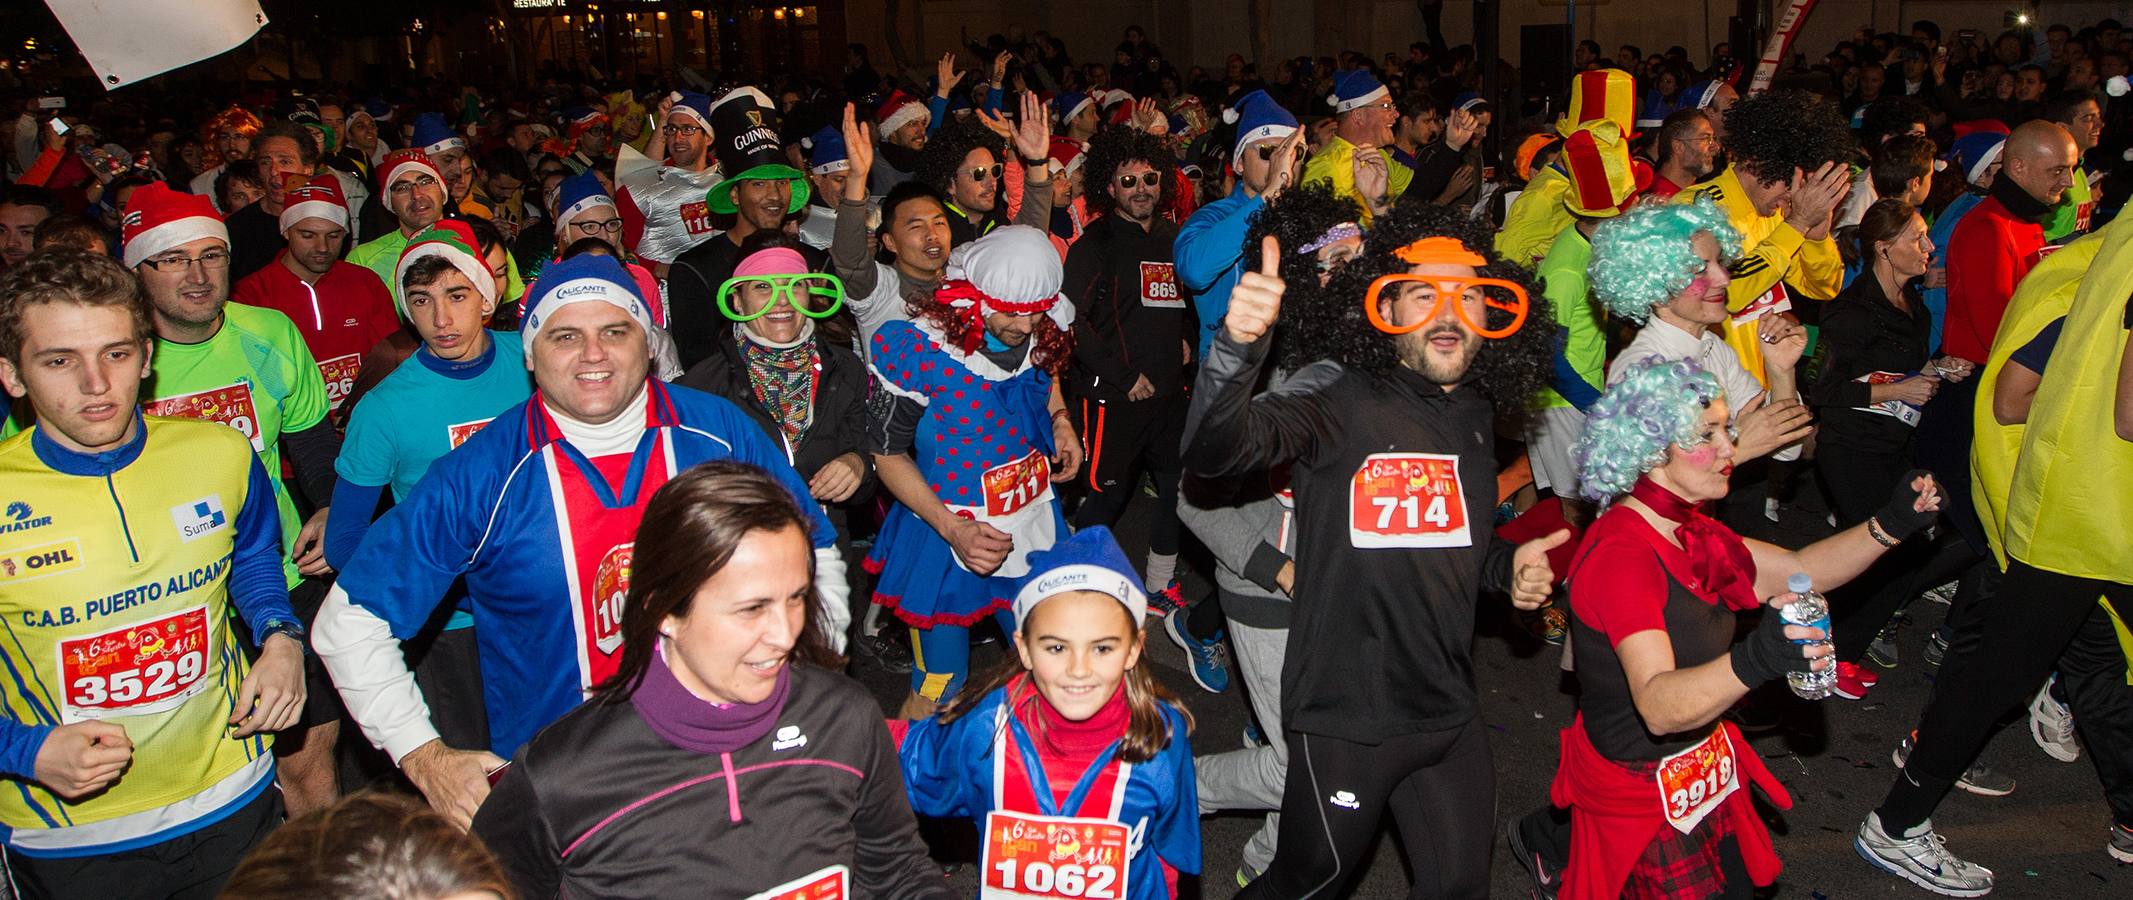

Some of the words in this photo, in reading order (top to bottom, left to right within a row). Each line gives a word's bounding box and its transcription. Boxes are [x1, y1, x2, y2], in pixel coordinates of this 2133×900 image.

[513, 0, 567, 8] RESTAURATE
[1149, 281, 1178, 298] 869
[999, 475, 1038, 512] 711
[1371, 495, 1450, 529] 714
[184, 519, 217, 537] Suma
[26, 549, 74, 569] OHL
[22, 606, 81, 628] C.A.B.
[86, 582, 162, 620] PUERTO
[165, 552, 233, 597] ALICANT
[598, 588, 631, 633] 10
[73, 650, 203, 706] 3529
[1671, 755, 1732, 818] 3918
[995, 858, 1117, 899] 1062
